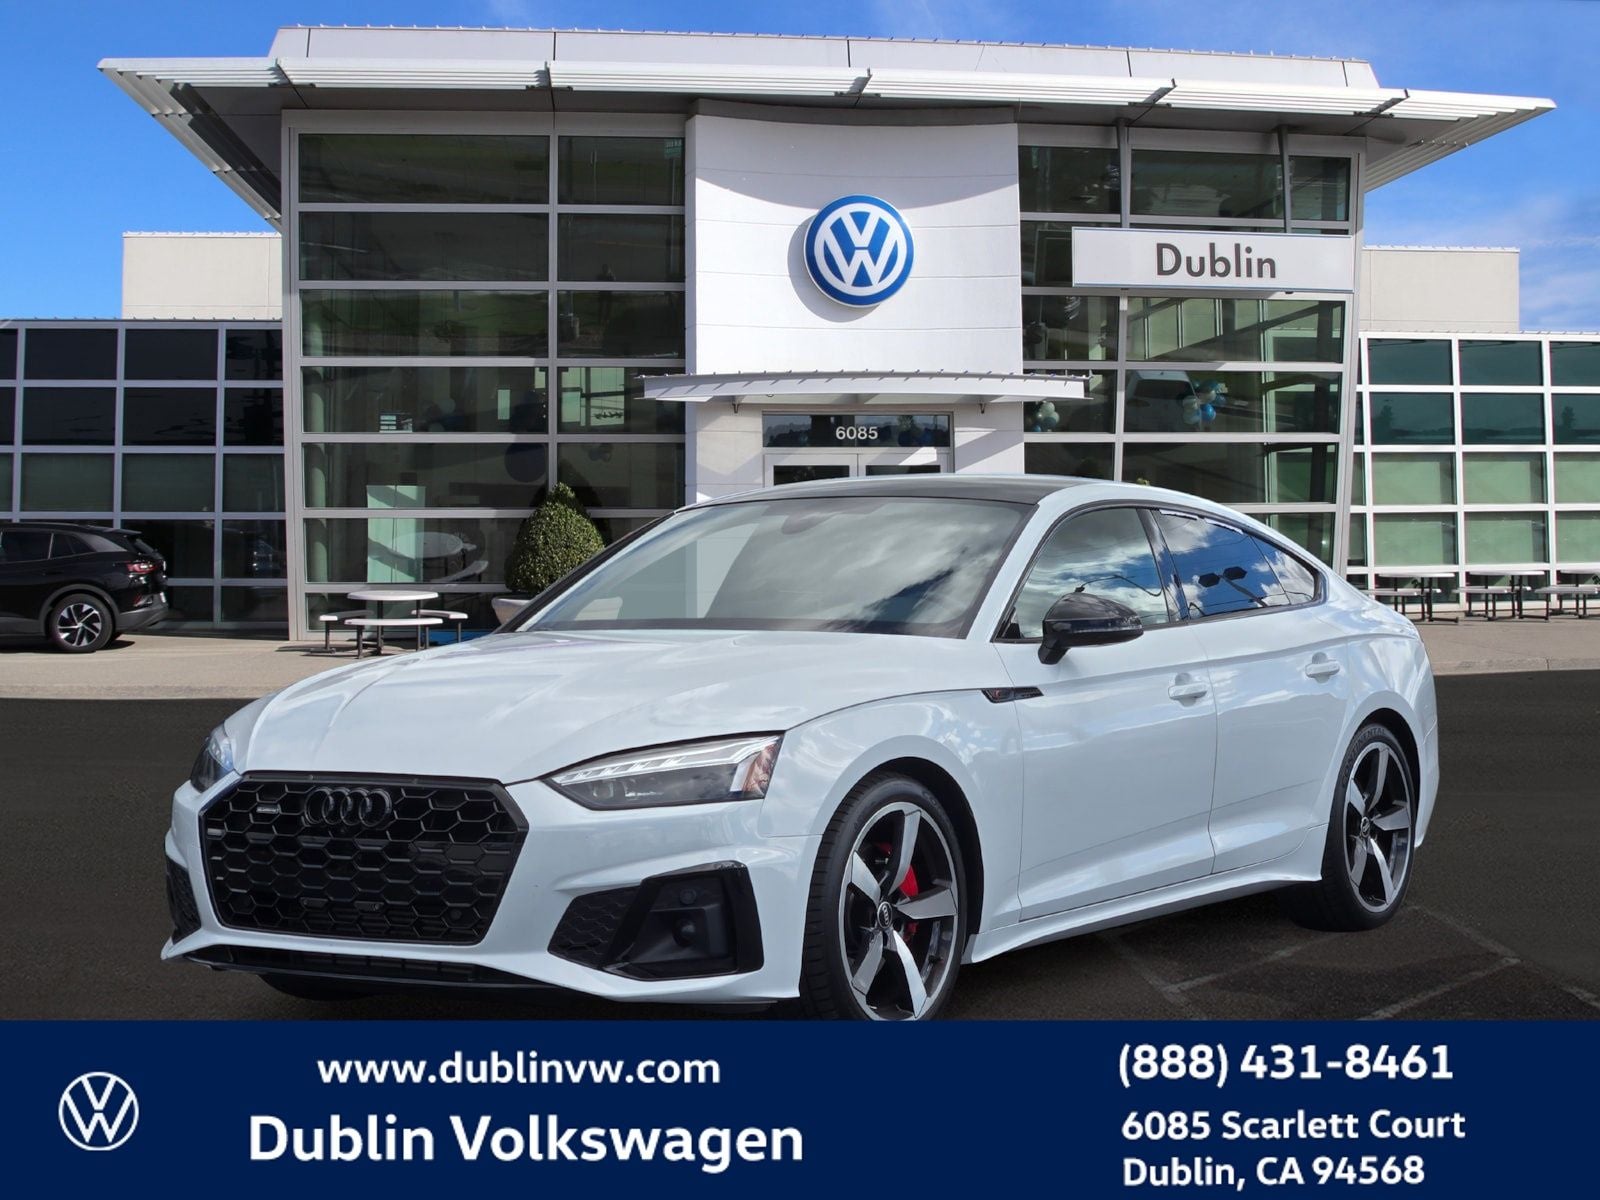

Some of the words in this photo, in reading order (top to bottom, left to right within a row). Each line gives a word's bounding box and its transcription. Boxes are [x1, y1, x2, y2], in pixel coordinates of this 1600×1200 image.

[818, 204, 904, 294] VW
[1156, 242, 1277, 279] Dublin
[834, 425, 879, 441] 6085
